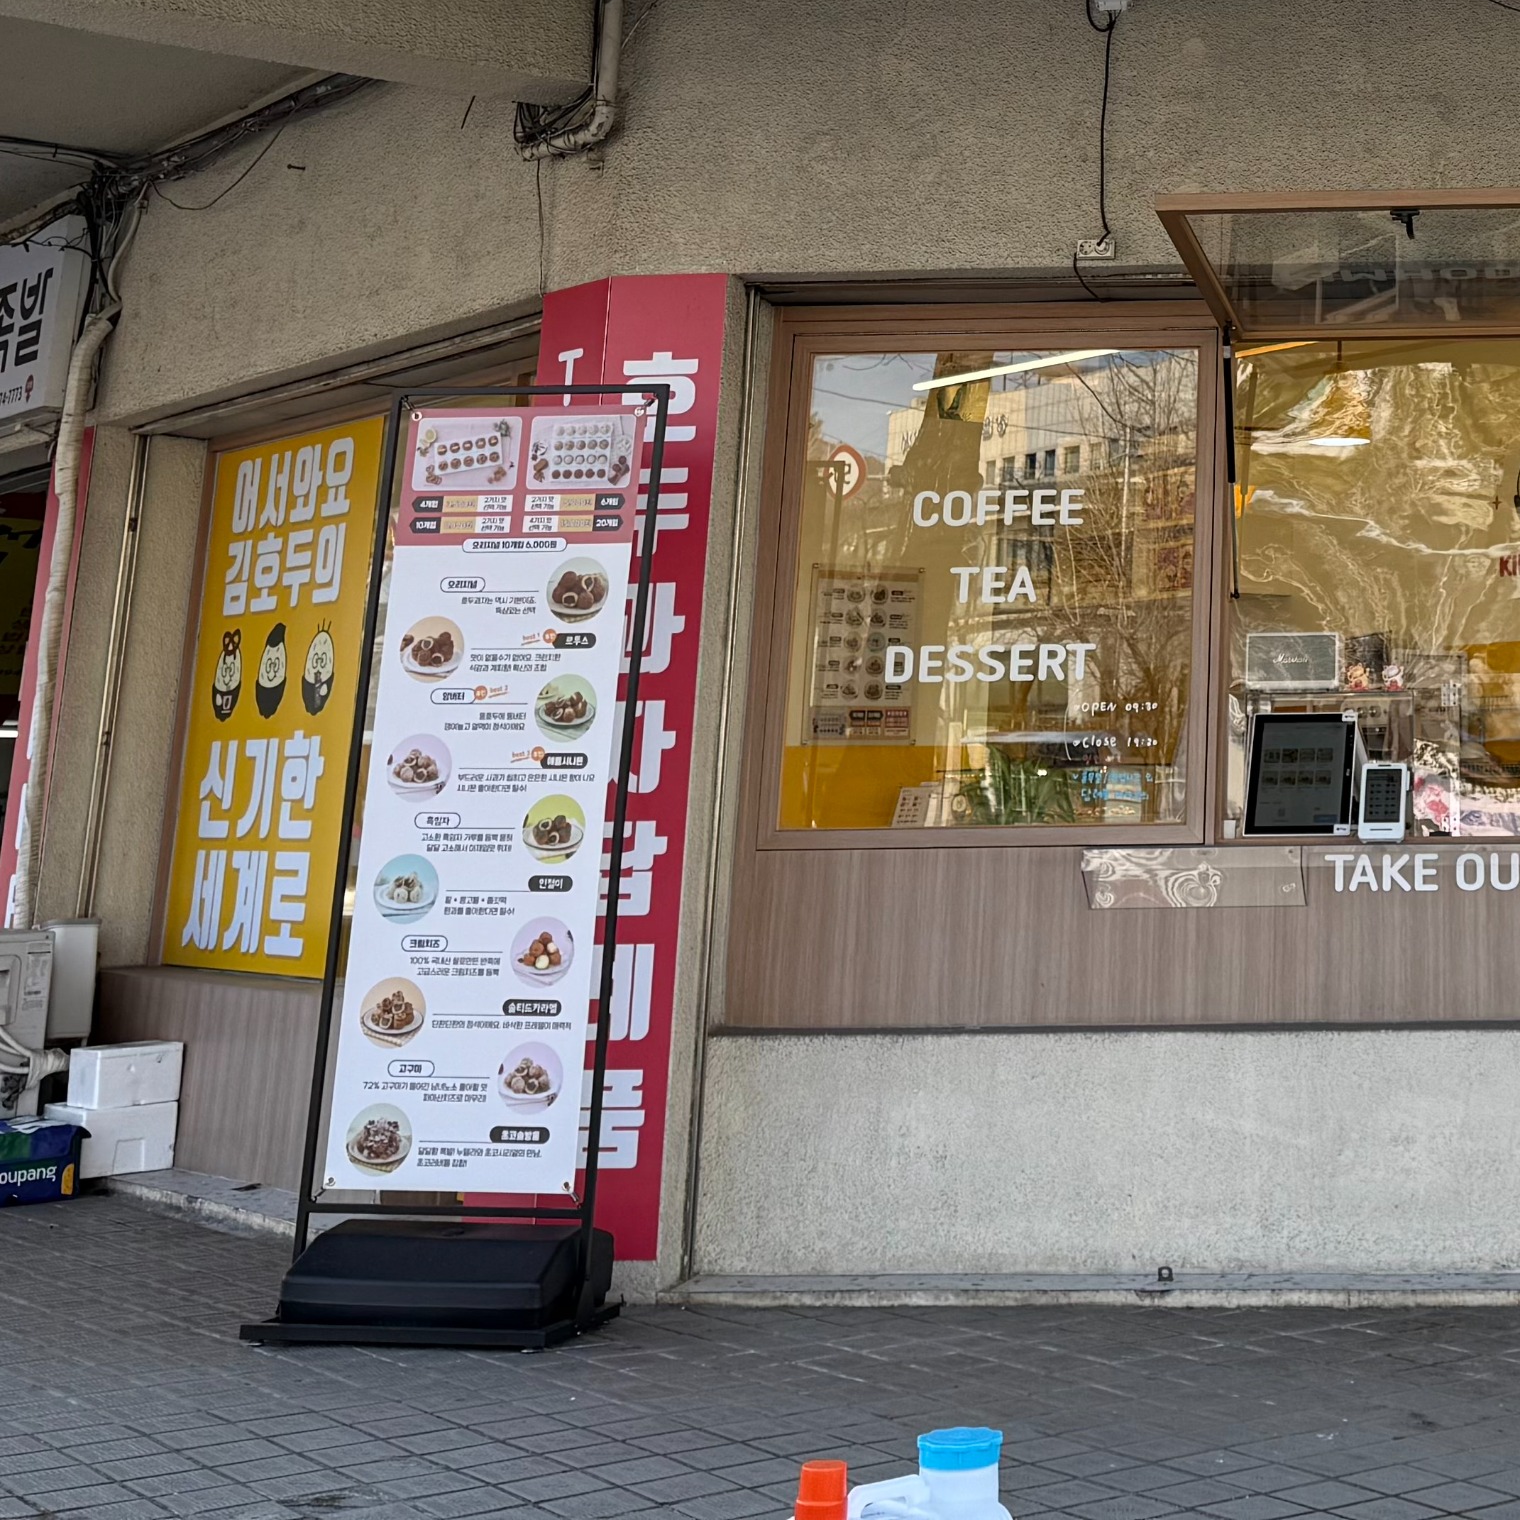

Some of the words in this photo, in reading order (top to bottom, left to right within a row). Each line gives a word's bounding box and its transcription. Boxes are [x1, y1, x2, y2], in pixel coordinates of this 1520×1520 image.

[231, 436, 355, 535] 어서와요
[912, 489, 1085, 527] COFFEE
[222, 522, 347, 617] 김호두의
[950, 566, 1037, 604] TEA
[884, 642, 1096, 684] DESSERT
[198, 729, 325, 839] 신기한
[181, 849, 311, 958] 세계로
[1324, 853, 1439, 893] TAKE
